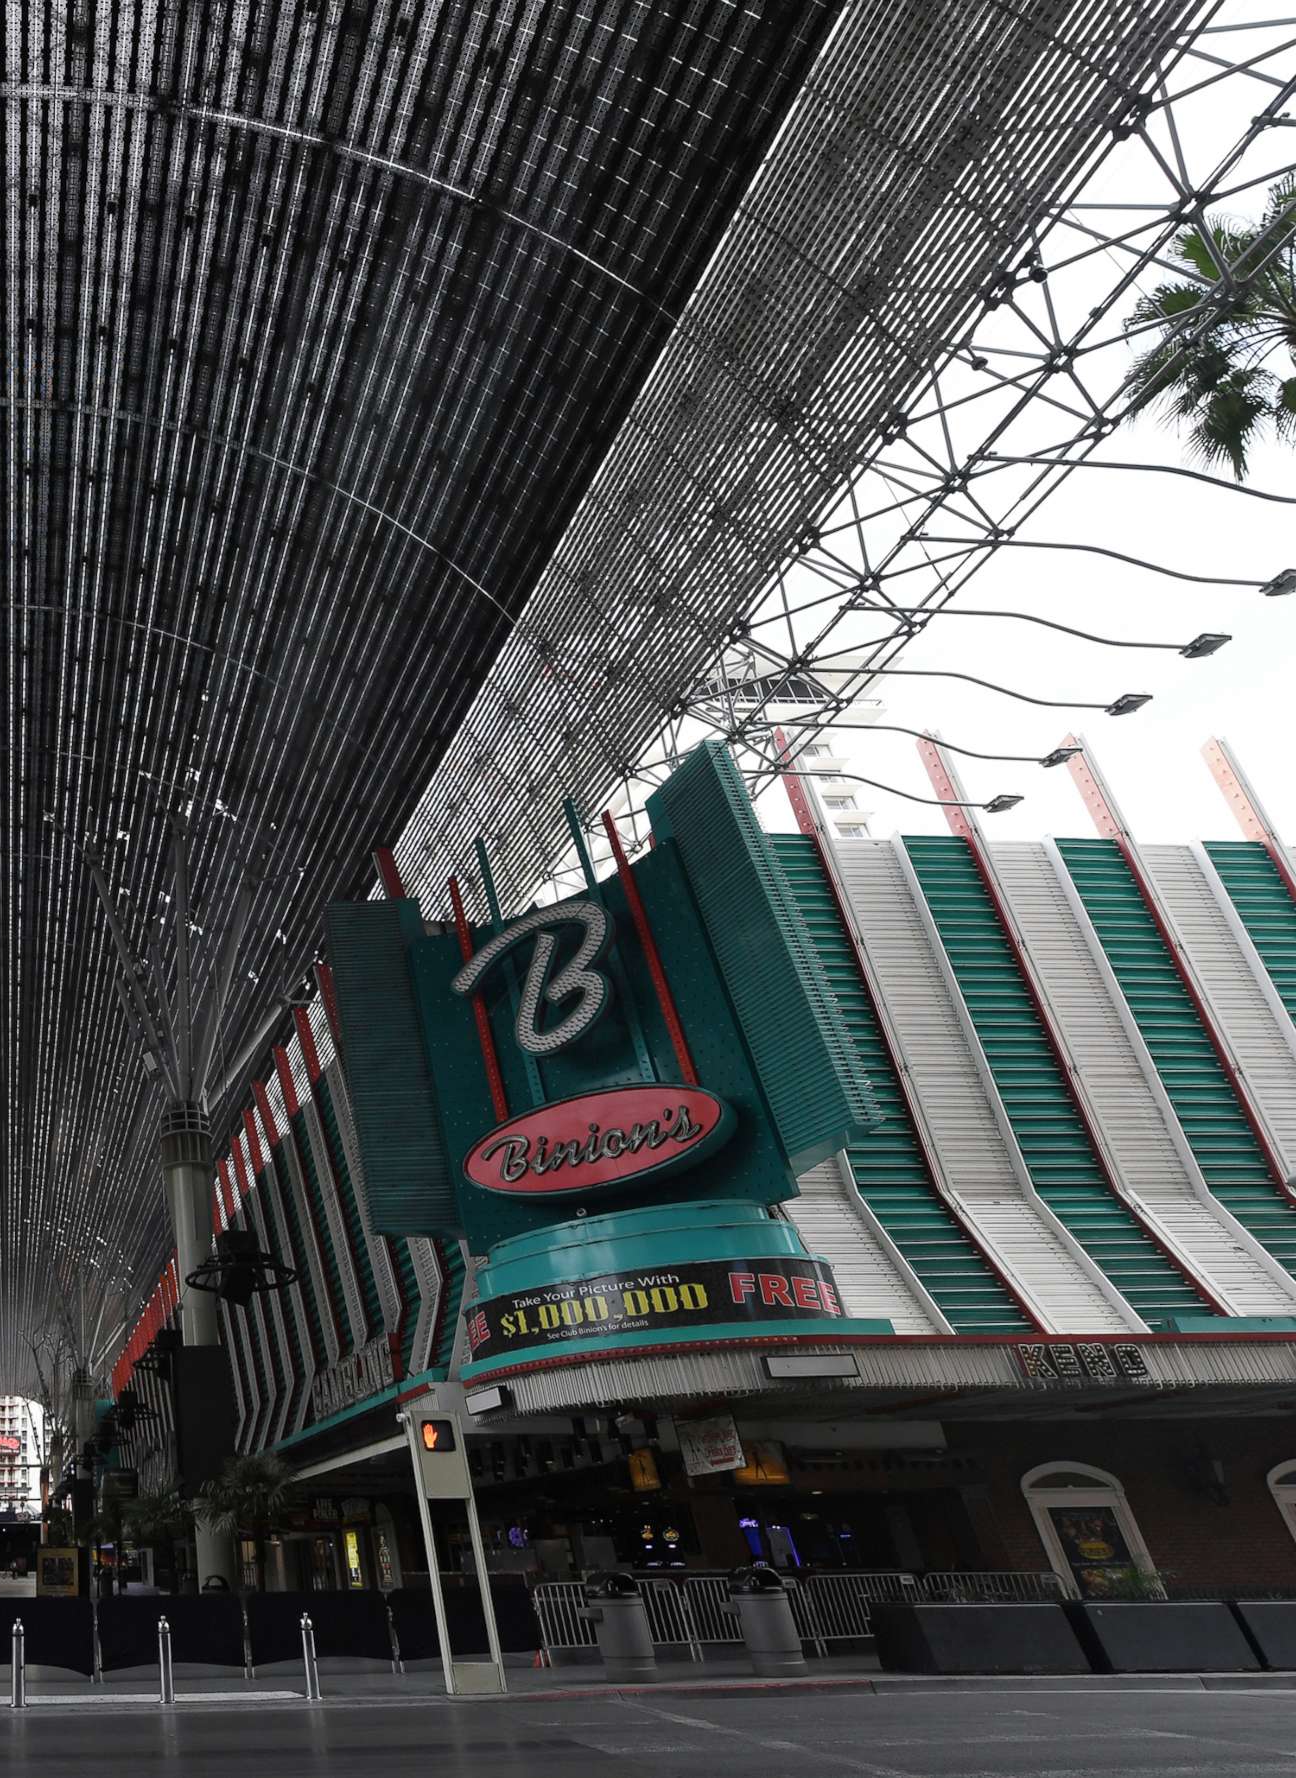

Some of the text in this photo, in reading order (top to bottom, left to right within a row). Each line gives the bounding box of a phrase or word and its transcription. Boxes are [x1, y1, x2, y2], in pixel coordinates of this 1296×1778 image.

[450, 900, 608, 1056] B
[482, 1104, 702, 1183] Binion's
[512, 1273, 680, 1309] Take Your Picture With
[728, 1271, 842, 1316] FREE
[547, 1319, 649, 1340] See Club Binion's for details
[1018, 1343, 1148, 1378] KENO
